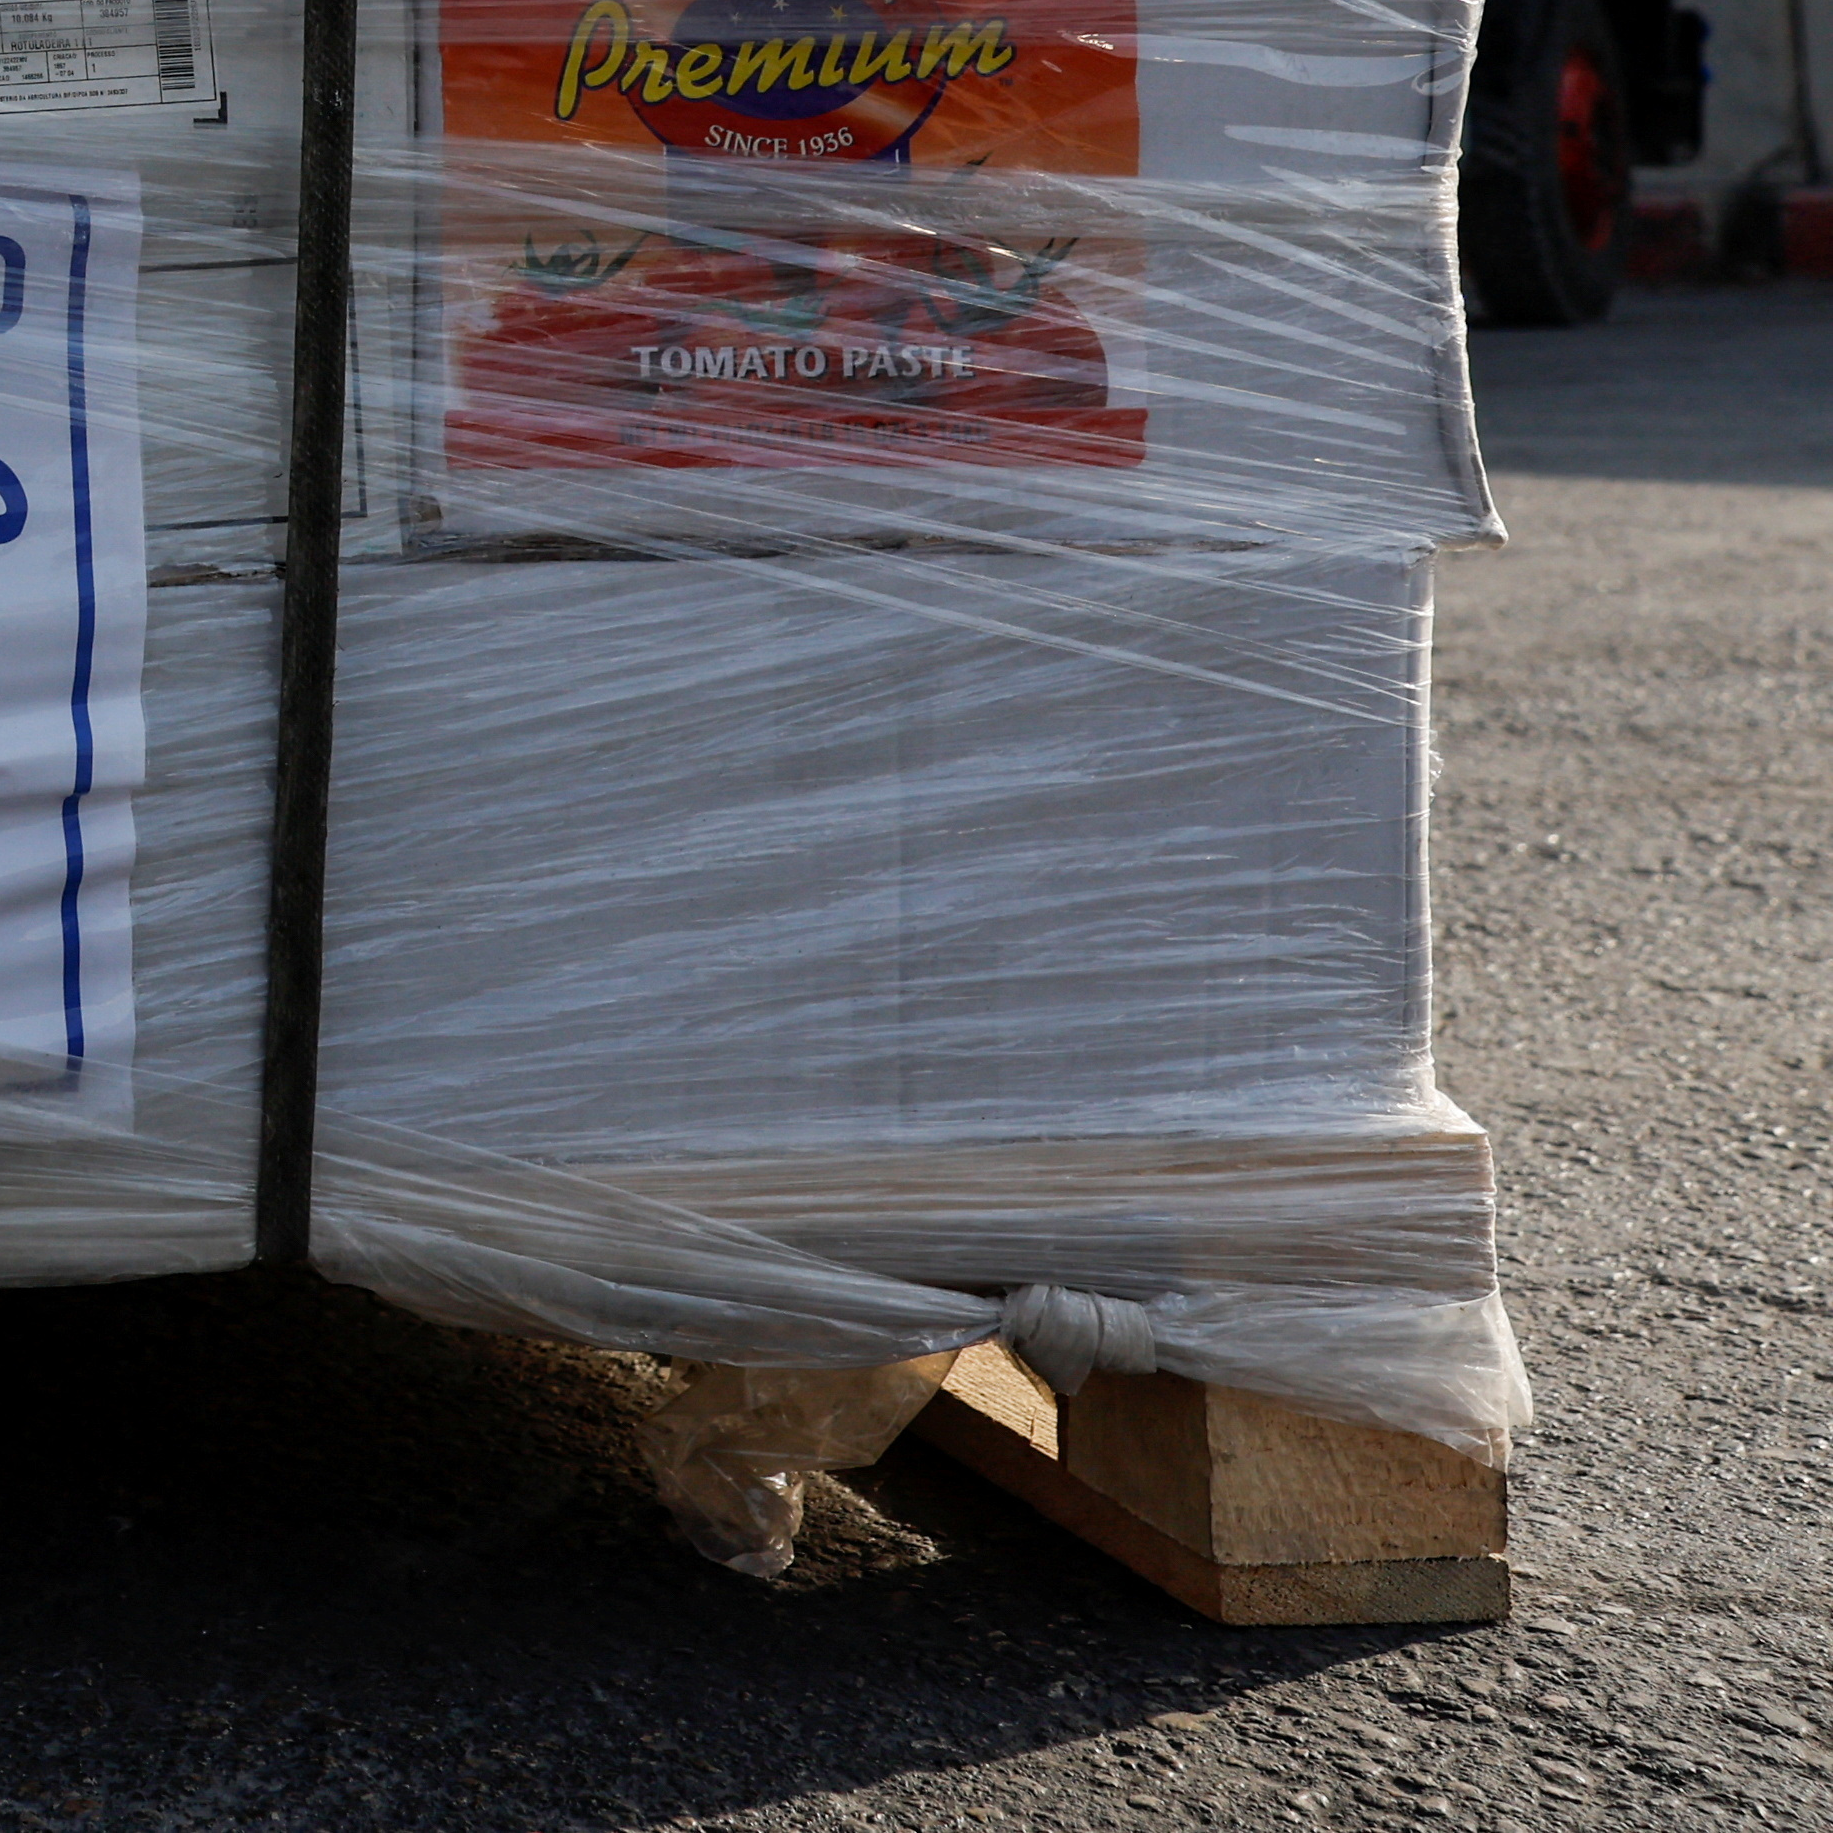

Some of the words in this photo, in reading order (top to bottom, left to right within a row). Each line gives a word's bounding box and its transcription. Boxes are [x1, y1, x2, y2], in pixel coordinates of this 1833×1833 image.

[10, 38, 71, 51] ROTULADEIRA
[704, 124, 789, 160] SINCE
[797, 126, 855, 161] 1936
[630, 345, 827, 379] TOMATO
[841, 345, 976, 379] PASTE
